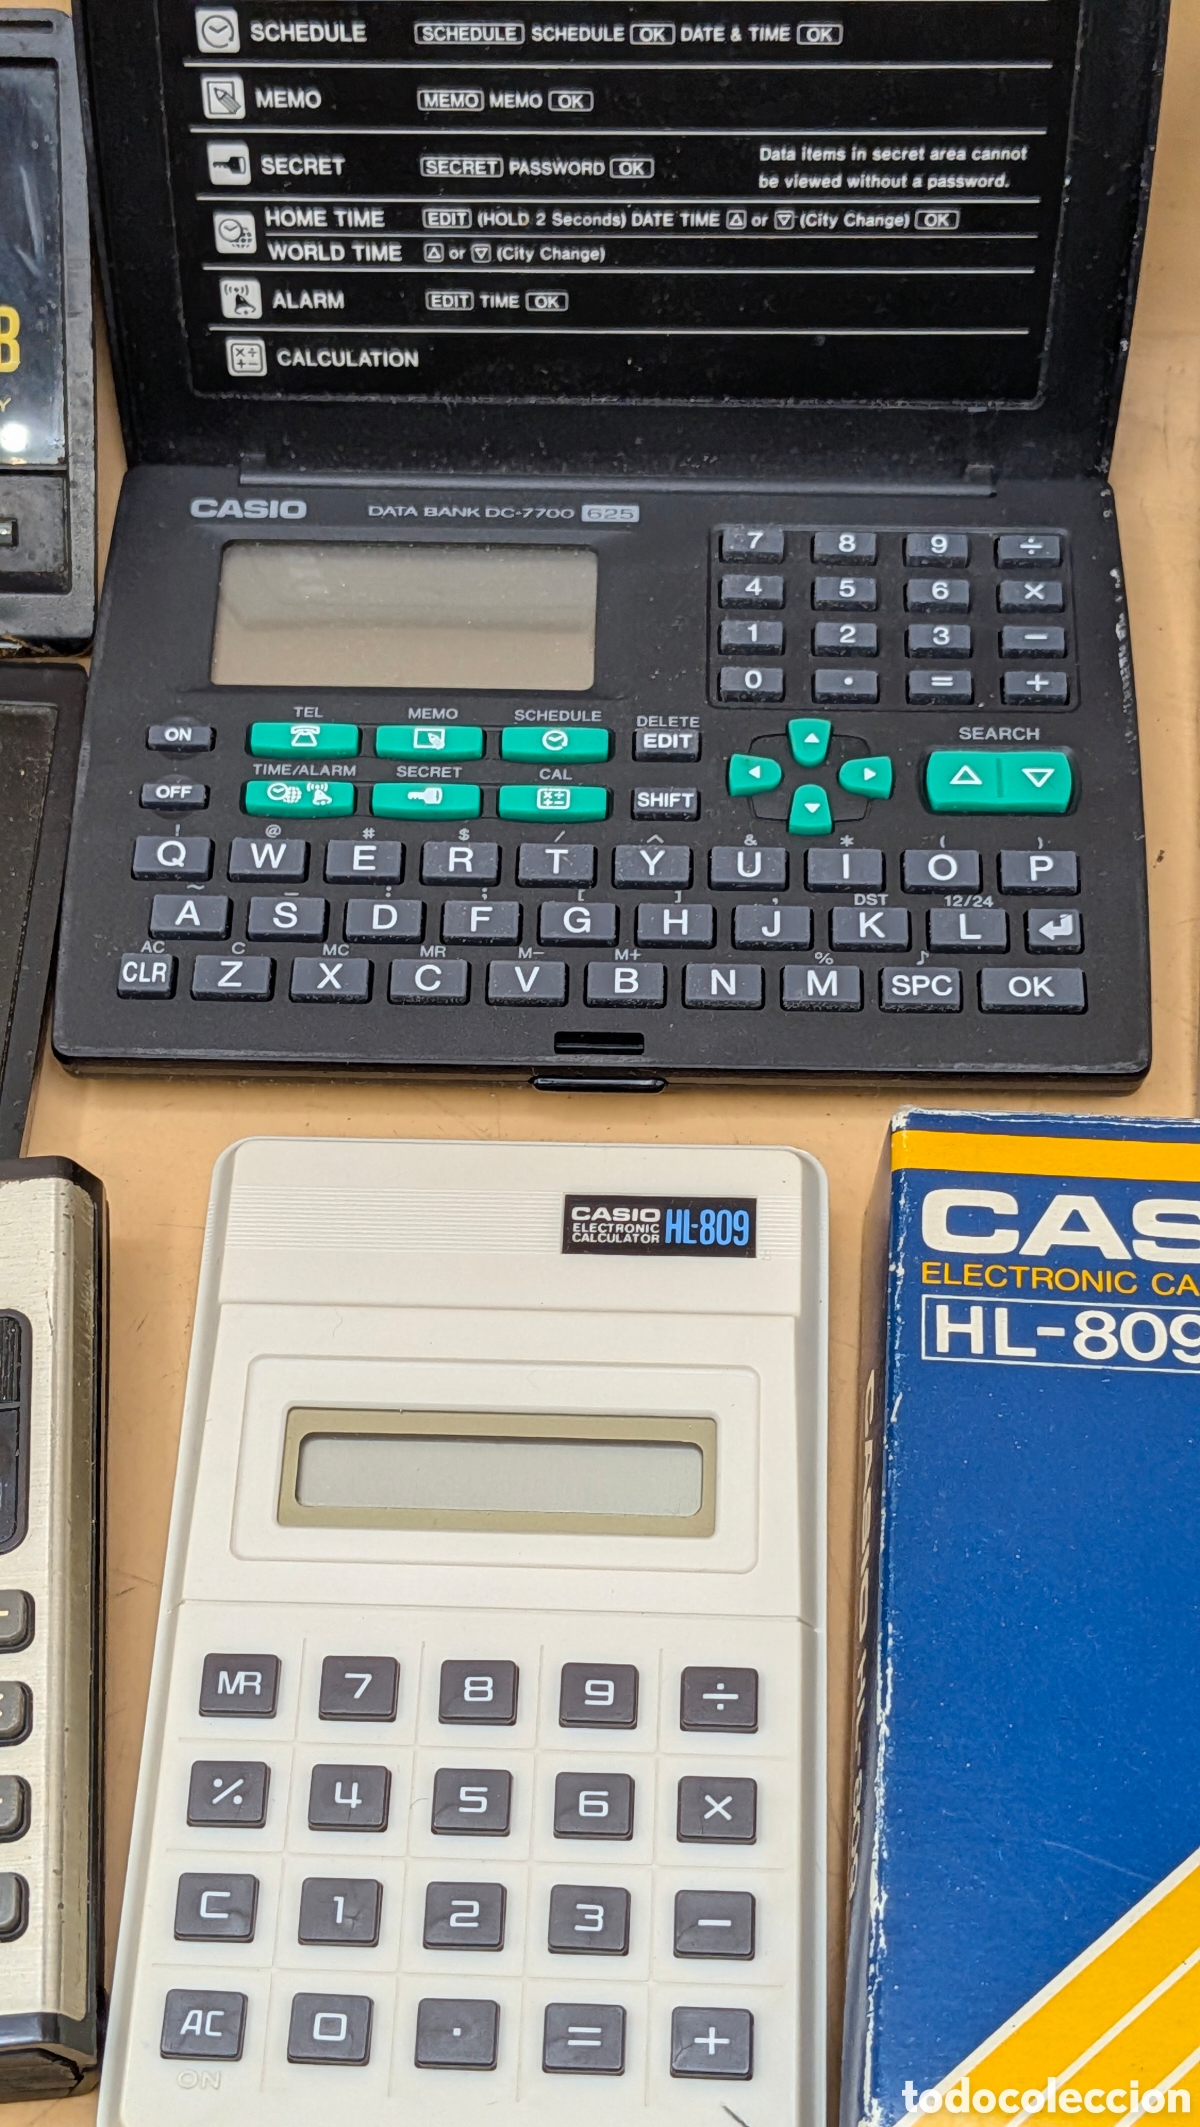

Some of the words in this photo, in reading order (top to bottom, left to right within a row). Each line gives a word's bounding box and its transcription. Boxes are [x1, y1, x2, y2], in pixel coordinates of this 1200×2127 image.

[251, 23, 367, 42] SCHEDULE
[422, 26, 517, 41] SCHEDULE
[532, 27, 624, 41] SCHEDULE
[639, 27, 665, 42] OK
[681, 27, 724, 41] DATE
[749, 27, 790, 41] TIME
[806, 27, 833, 42] OK
[256, 90, 321, 108] MEMO
[424, 93, 479, 108] MEMO
[490, 94, 542, 108] MEMO
[558, 93, 584, 109] OK
[760, 148, 795, 161] Data
[802, 147, 845, 161] items
[852, 147, 866, 160] in
[873, 148, 924, 160] secret
[930, 150, 966, 160] area
[972, 147, 1027, 160] cannot
[262, 157, 345, 175] SECRET
[426, 160, 498, 174] SECRET
[509, 161, 605, 175] PASSWORD
[619, 162, 645, 175] OK
[759, 175, 778, 188] be
[785, 174, 841, 188] viewed
[847, 174, 907, 188] without
[913, 178, 922, 187] a
[928, 174, 1009, 190] password.
[266, 210, 327, 226] HOME
[334, 210, 385, 227] TIME
[428, 212, 467, 225] EDIT
[478, 212, 529, 227] (HOLD
[536, 213, 545, 225] 2
[552, 212, 626, 228] Seconds)
[632, 213, 673, 226] DATE
[680, 213, 719, 226] TIME
[752, 216, 768, 226] or
[800, 213, 838, 229] (City
[844, 213, 910, 229] Change)
[924, 213, 950, 227] OK
[268, 244, 345, 260] WORLD
[352, 244, 402, 261] TIME
[449, 249, 465, 259] or
[497, 247, 534, 262] (City
[540, 247, 605, 262] Change)
[273, 292, 344, 308] ALARM
[431, 294, 469, 308] EDIT
[480, 295, 519, 308] TIME
[535, 294, 560, 308] OK
[277, 350, 418, 367] CALCULATION
[191, 500, 306, 518] CASIO
[369, 506, 418, 517] DATA
[424, 507, 480, 517] BANK
[485, 508, 574, 518] DC-7700
[587, 507, 634, 520] 625
[748, 531, 763, 548] 7
[839, 534, 855, 552] 8
[931, 535, 947, 553] 9
[746, 578, 762, 595] 4
[840, 579, 855, 597] 5
[932, 582, 948, 599] 6
[748, 624, 757, 641] 1
[840, 625, 855, 643] 2
[933, 627, 949, 644] 3
[745, 670, 762, 688] 0
[294, 707, 323, 717] TEL
[409, 708, 458, 719] MEMO
[515, 710, 601, 721] SCHEDULE
[637, 716, 699, 727] DELETE
[165, 728, 191, 741] ON
[644, 734, 692, 748] EDIT
[959, 727, 1039, 740] SEARCH
[253, 764, 356, 776] TIME/ALARM
[397, 766, 462, 778] SECRET
[540, 769, 572, 780] CAL
[156, 785, 192, 798] OFF
[638, 792, 694, 807] SHIFT
[157, 841, 186, 867] Q
[251, 843, 286, 868] W
[353, 846, 376, 870] E
[449, 847, 473, 872] R
[545, 849, 568, 873] T
[640, 850, 665, 875] Y
[738, 852, 761, 877] U
[843, 854, 849, 878] I
[928, 854, 957, 880] O
[1030, 856, 1053, 881] P
[855, 894, 888, 905] DST
[945, 895, 993, 907] 12/24
[175, 901, 200, 925] A
[273, 902, 297, 928] S
[373, 905, 397, 929] D
[471, 907, 492, 931] F
[564, 907, 590, 933] G
[664, 909, 688, 935] H
[762, 911, 780, 937] J
[860, 912, 885, 937] K
[960, 914, 981, 939] L
[141, 941, 164, 953] AC
[232, 942, 245, 954] C
[323, 944, 349, 955] MC
[420, 946, 446, 957] MR
[615, 949, 641, 960] M+
[123, 962, 166, 982] CLR
[218, 961, 242, 986] Z
[317, 963, 342, 988] X
[415, 965, 441, 991] C
[515, 967, 539, 992] V
[615, 968, 638, 993] B
[712, 970, 735, 995] N
[808, 970, 837, 996] M
[892, 975, 952, 995] SPC
[1009, 977, 1054, 997] OK
[572, 1207, 660, 1222] CASIO
[573, 1223, 659, 1234] ELECTRONIC
[665, 1209, 749, 1245] HL-809
[572, 1234, 660, 1244] CALCULATOR
[922, 1262, 1137, 1293] ELECTRONIC
[936, 1304, 1200, 1364] HL-809
[218, 1671, 261, 1695] MR
[345, 1673, 372, 1698] 7
[464, 1677, 493, 1701] 8
[585, 1680, 614, 1705] 9
[335, 1782, 362, 1808] 4
[459, 1787, 487, 1812] 5
[579, 1791, 608, 1816] 6
[200, 1891, 230, 1918] C
[334, 1897, 344, 1923] 1
[450, 1901, 479, 1927] 2
[575, 1904, 603, 1931] 3
[181, 2010, 224, 2036] AC
[313, 2013, 347, 2041] 0
[177, 2069, 221, 2089] ON
